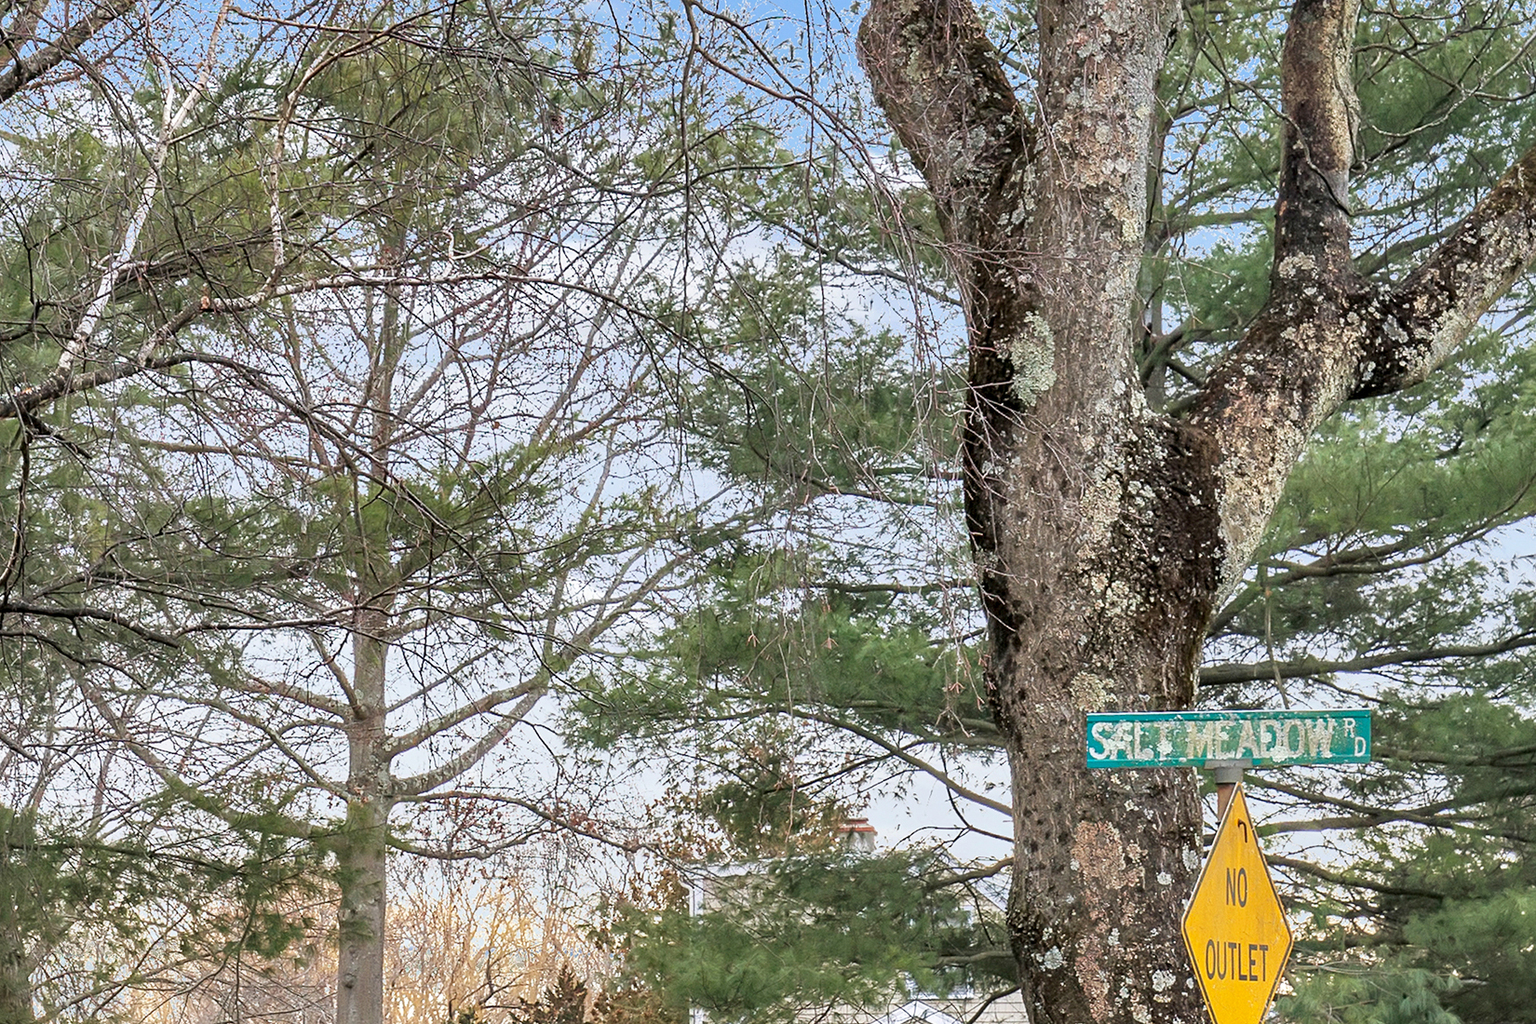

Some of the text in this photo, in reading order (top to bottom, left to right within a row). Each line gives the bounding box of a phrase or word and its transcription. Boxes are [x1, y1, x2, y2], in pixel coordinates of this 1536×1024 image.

[1089, 720, 1174, 760] SALT
[1187, 717, 1338, 760] MEADOW
[1226, 867, 1248, 908] NO
[1205, 938, 1269, 982] OUTLET
